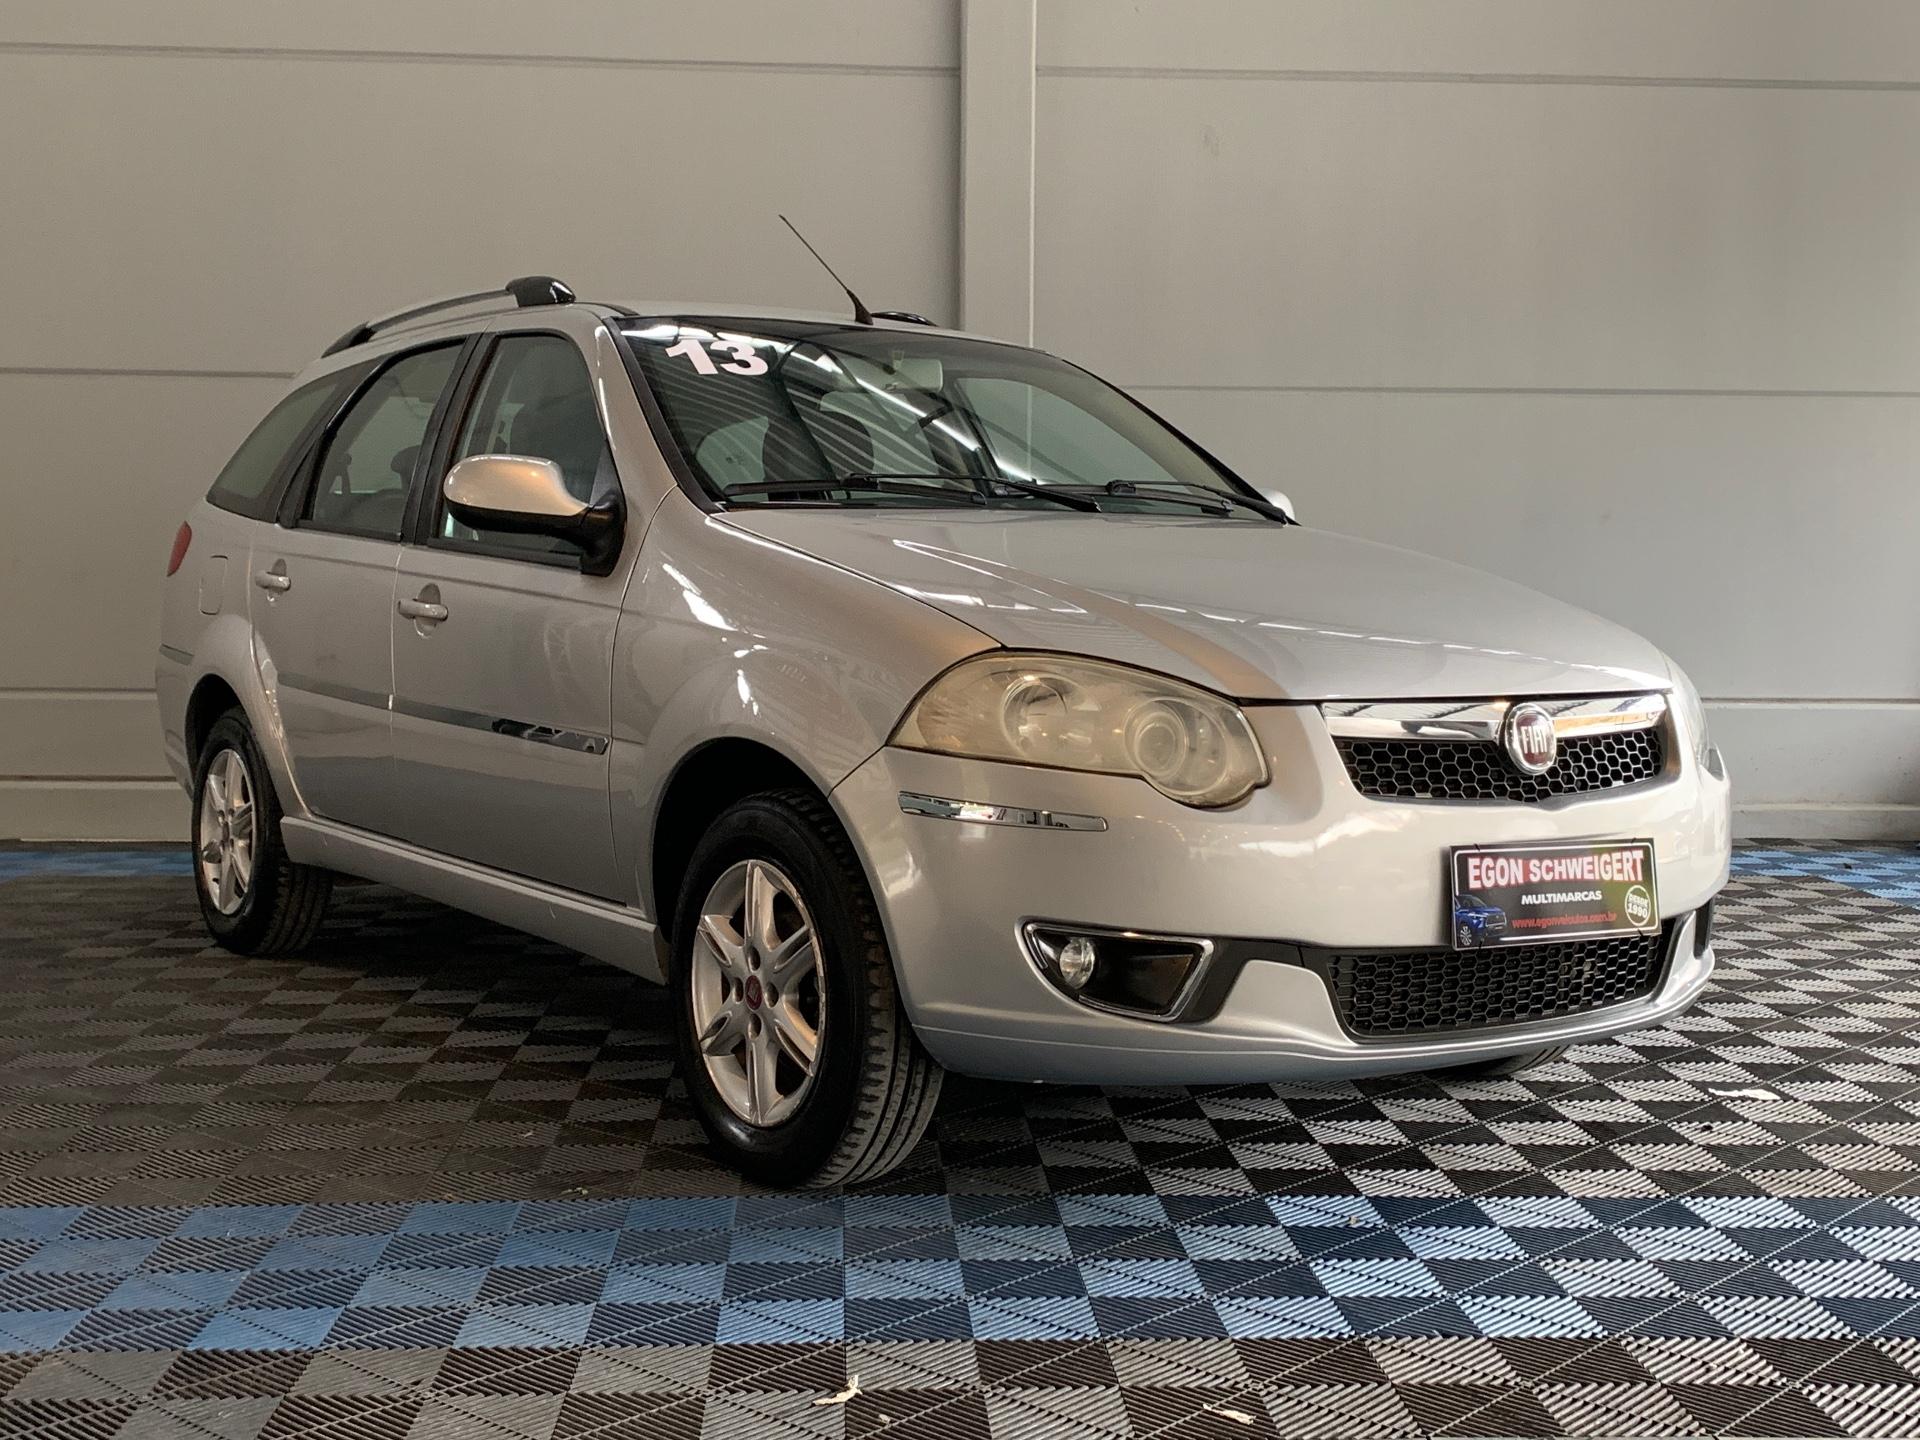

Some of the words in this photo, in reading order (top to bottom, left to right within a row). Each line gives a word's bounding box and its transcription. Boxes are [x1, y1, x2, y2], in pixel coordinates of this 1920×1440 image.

[665, 338, 769, 376] 13
[1520, 725, 1549, 754] FIAT
[1467, 856, 1524, 889] EGON
[1529, 850, 1645, 882] SCHWEIGERT
[1521, 890, 1603, 905] MULTIMARCAS
[1627, 903, 1649, 919] 1990
